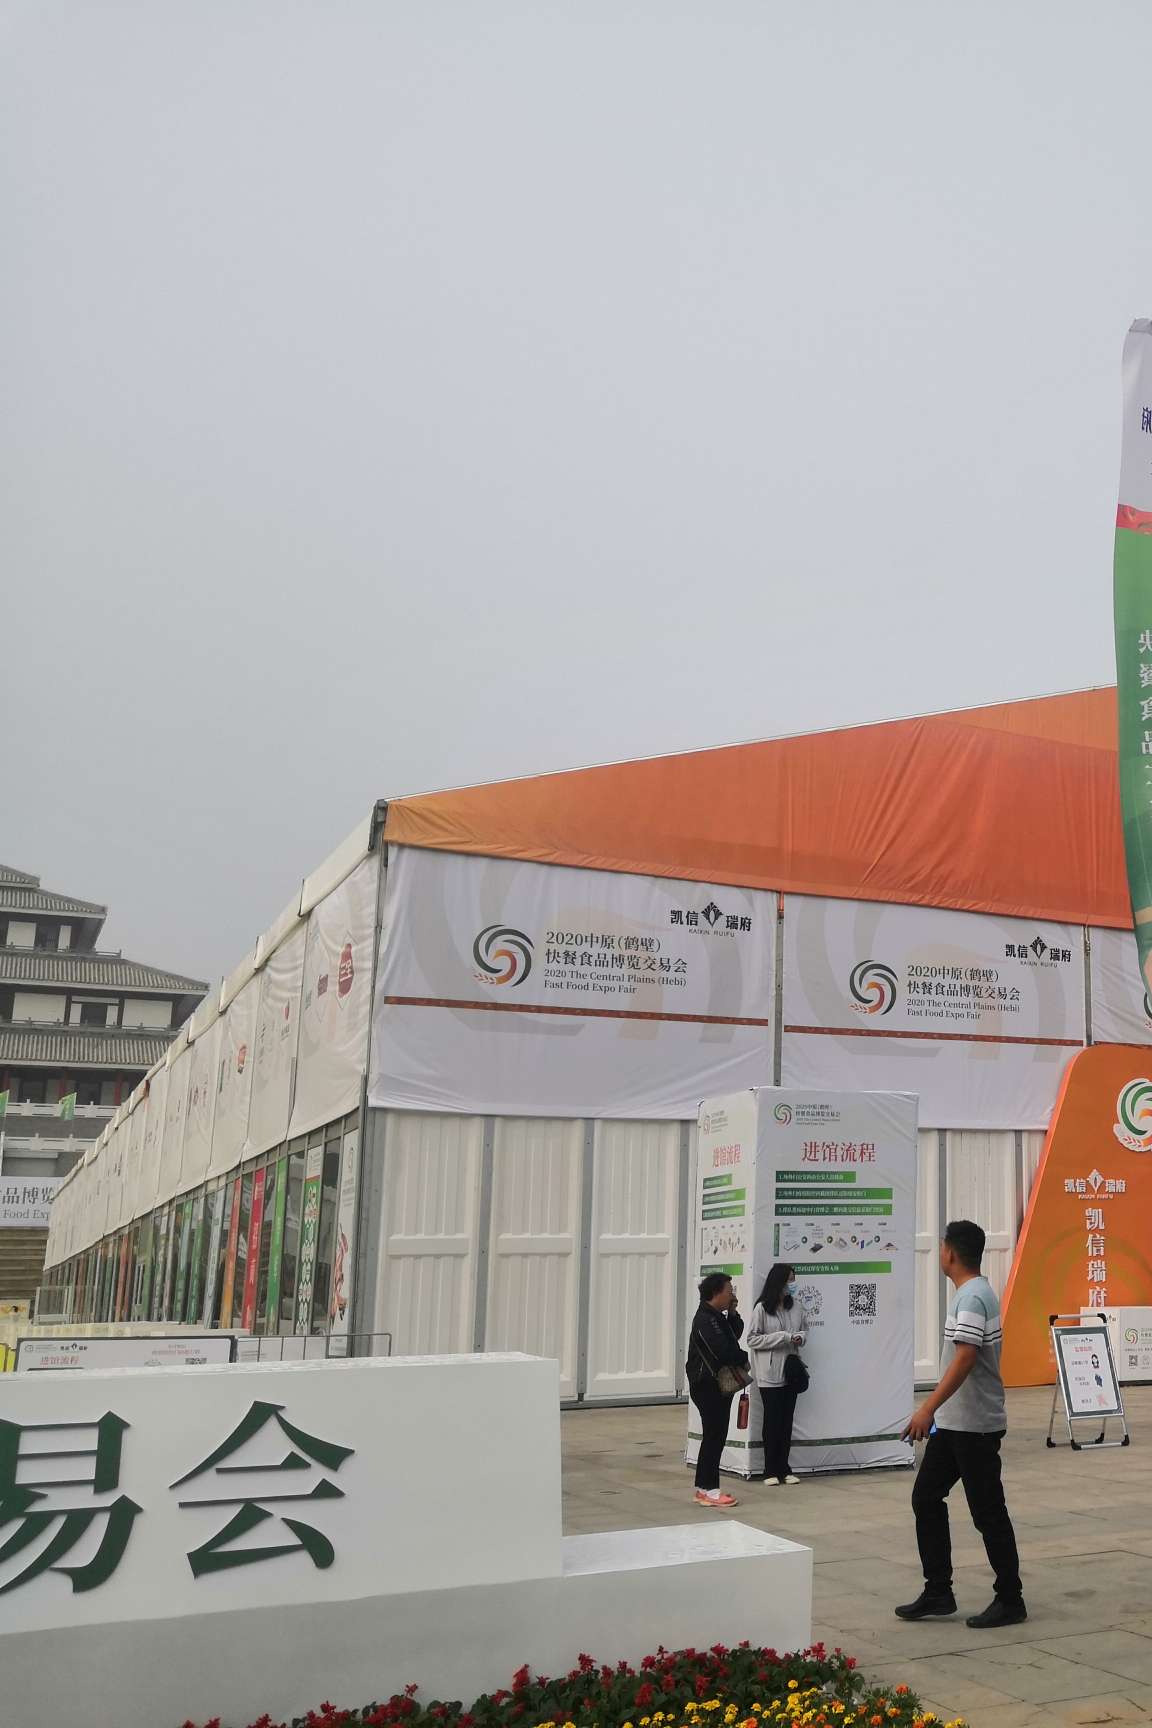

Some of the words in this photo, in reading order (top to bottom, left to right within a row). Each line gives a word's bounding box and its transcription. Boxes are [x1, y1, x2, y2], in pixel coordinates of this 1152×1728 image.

[670, 909, 699, 926] 凯信
[726, 915, 752, 932] 瑞府
[546, 931, 661, 953] 2020中原(鹤壁)
[546, 949, 688, 974] 快餐食品博览交易会
[1005, 944, 1028, 959] 凯信
[1050, 948, 1071, 963] 瑞府
[544, 969, 567, 979] 2020
[568, 970, 587, 980] The
[589, 971, 625, 982] Central
[627, 973, 656, 985] Plains
[658, 976, 687, 987] (Hebi)
[907, 964, 999, 983] 2020中原(鹤壁)
[544, 979, 563, 990] Fast
[566, 981, 590, 991] Food
[592, 982, 616, 994] Expo
[618, 985, 638, 994] Fair
[907, 980, 1020, 1001] 快餐食品博览交易会
[907, 998, 925, 1007] 2020
[926, 999, 942, 1008] The
[943, 1000, 972, 1010] Central
[973, 1002, 996, 1012] Plains
[907, 1009, 923, 1018] Fast
[925, 1010, 944, 1019] Food
[945, 1010, 965, 1020] Expo
[966, 1012, 981, 1020] Fair
[801, 1141, 876, 1162] 进馆流程
[0, 1186, 55, 1204] 品博览
[1064, 1178, 1086, 1193] 凯信
[1105, 1179, 1126, 1193] 瑞府
[3, 1208, 30, 1219] Food
[1085, 1208, 1107, 1307] 凯信瑞府
[0, 1400, 354, 1593] 易会
